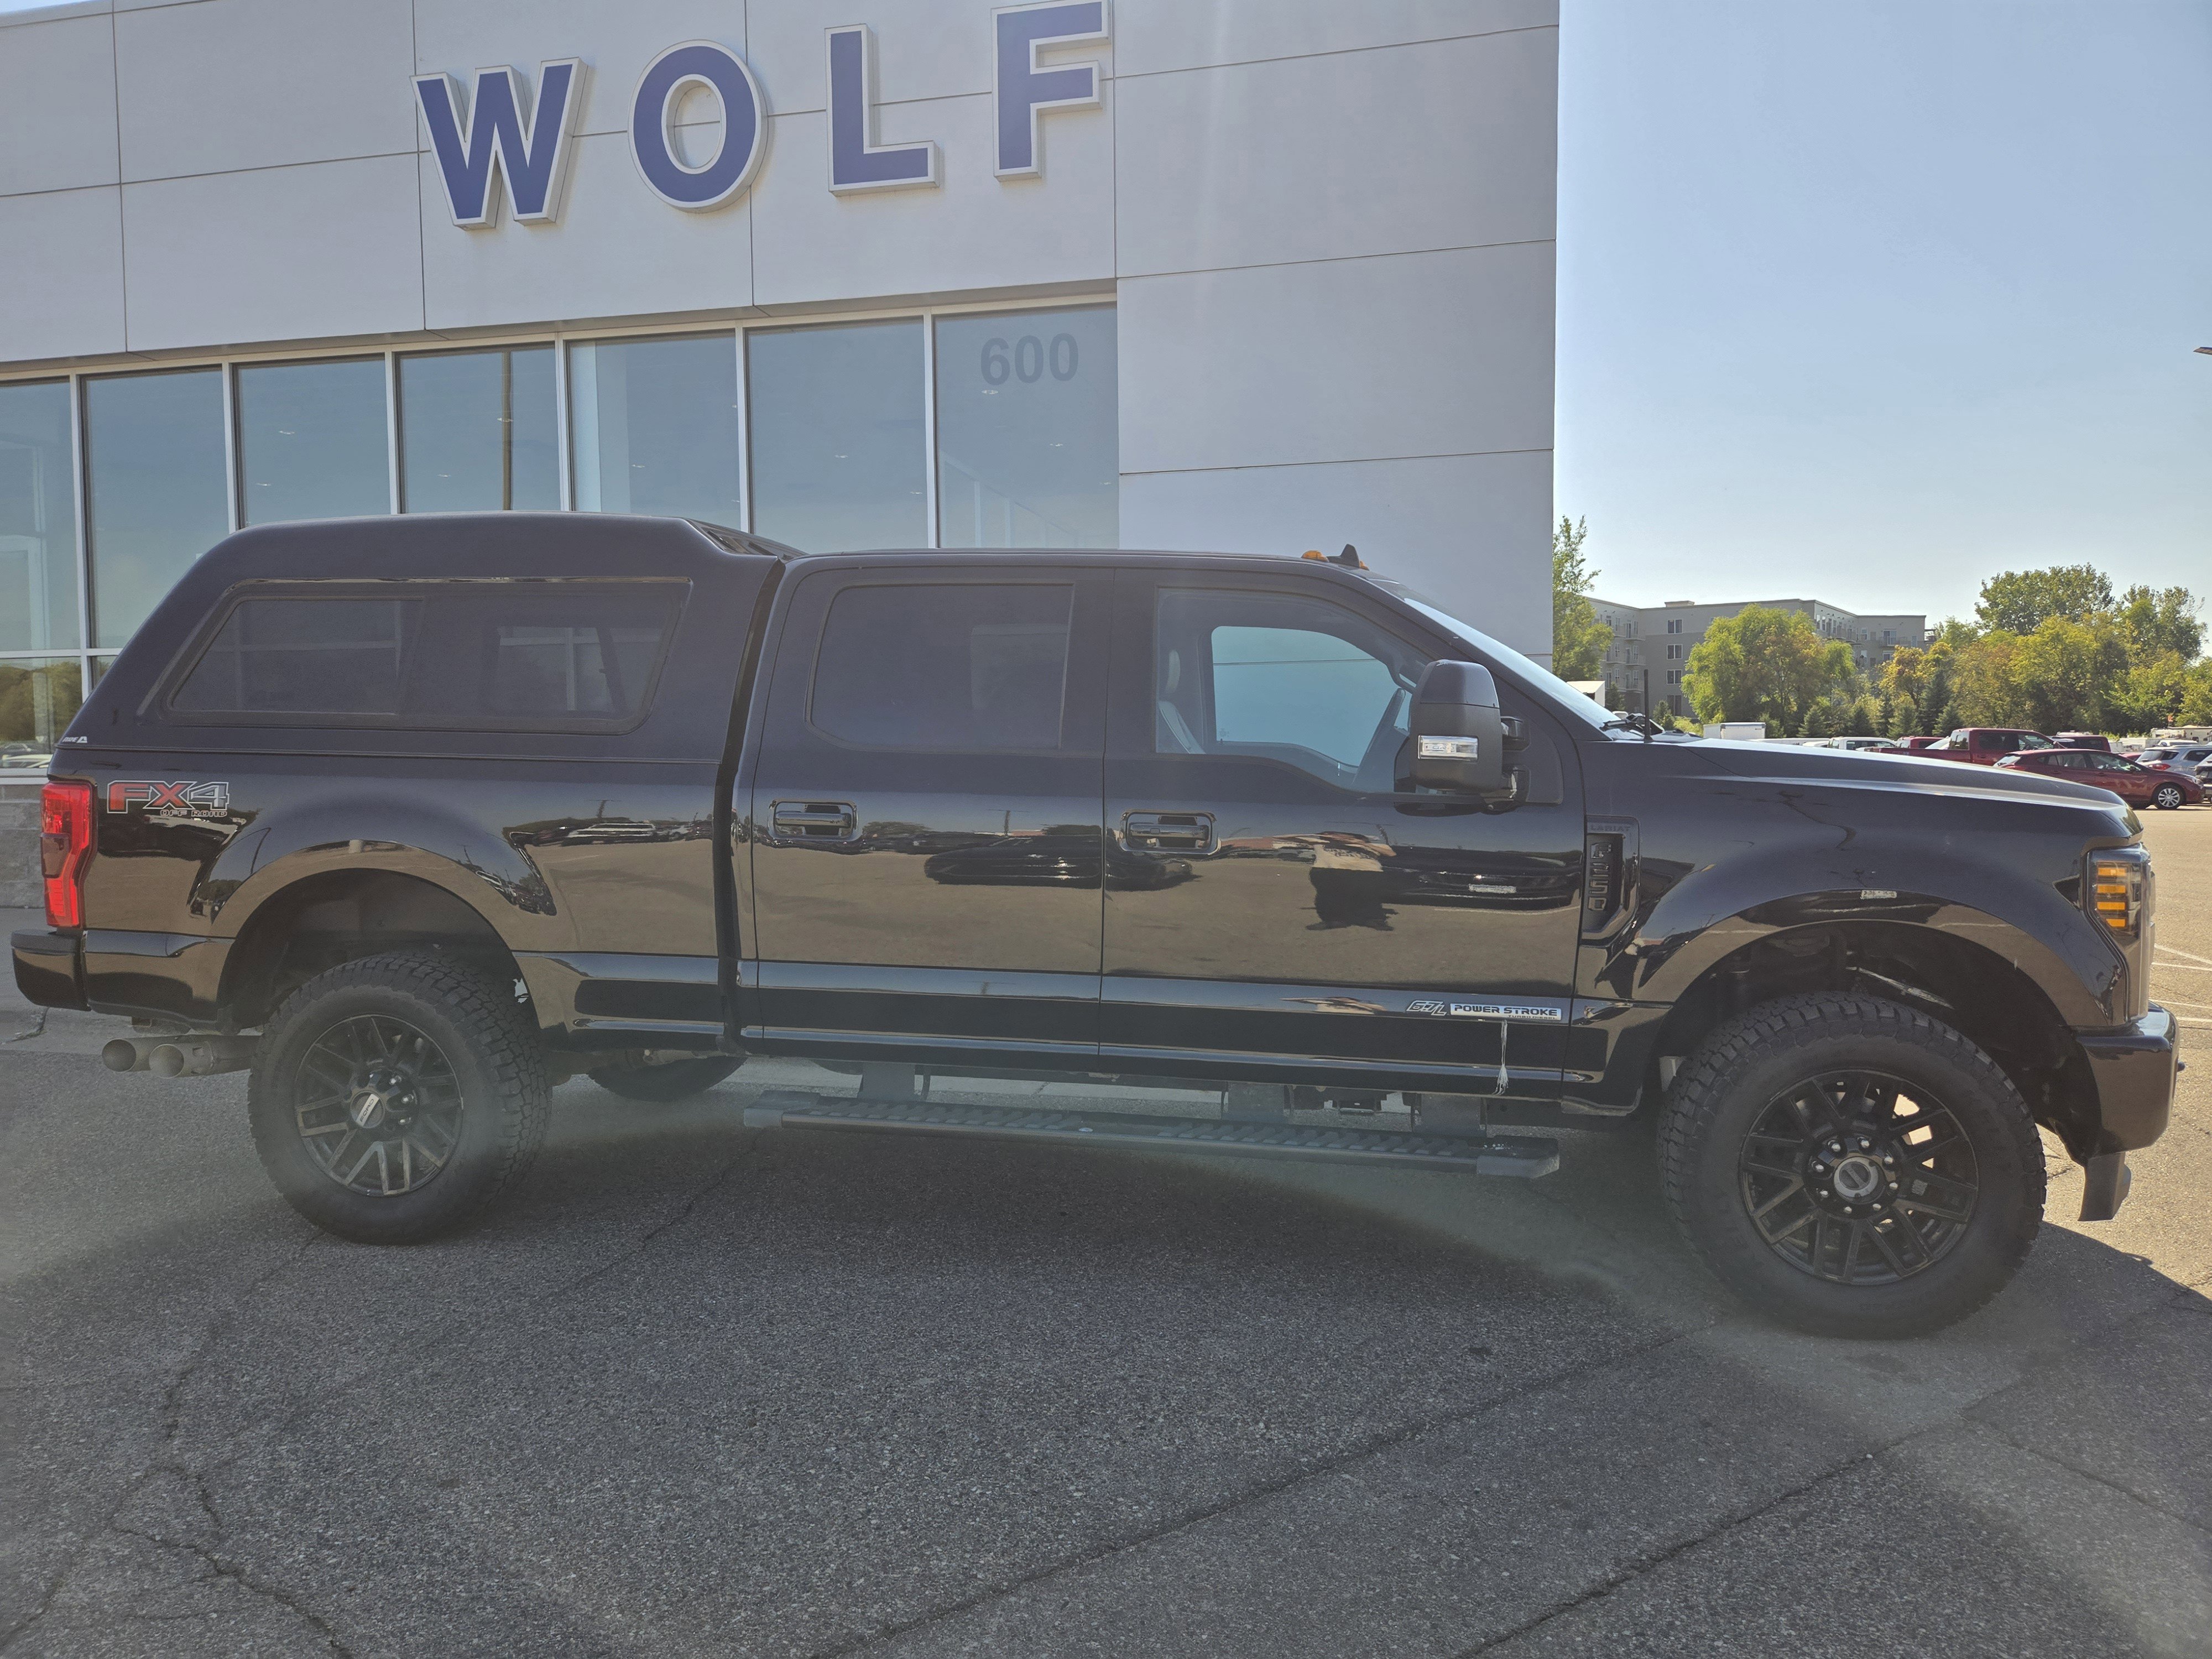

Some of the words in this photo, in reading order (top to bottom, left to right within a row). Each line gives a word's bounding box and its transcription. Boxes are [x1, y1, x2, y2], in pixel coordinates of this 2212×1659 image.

[410, 1, 1109, 229] WOLF
[980, 333, 1078, 386] 600
[107, 780, 230, 814] FX4
[1454, 1004, 1500, 1014] POWER
[1504, 1007, 1558, 1016] STROKE
[359, 1098, 374, 1122] FORD
